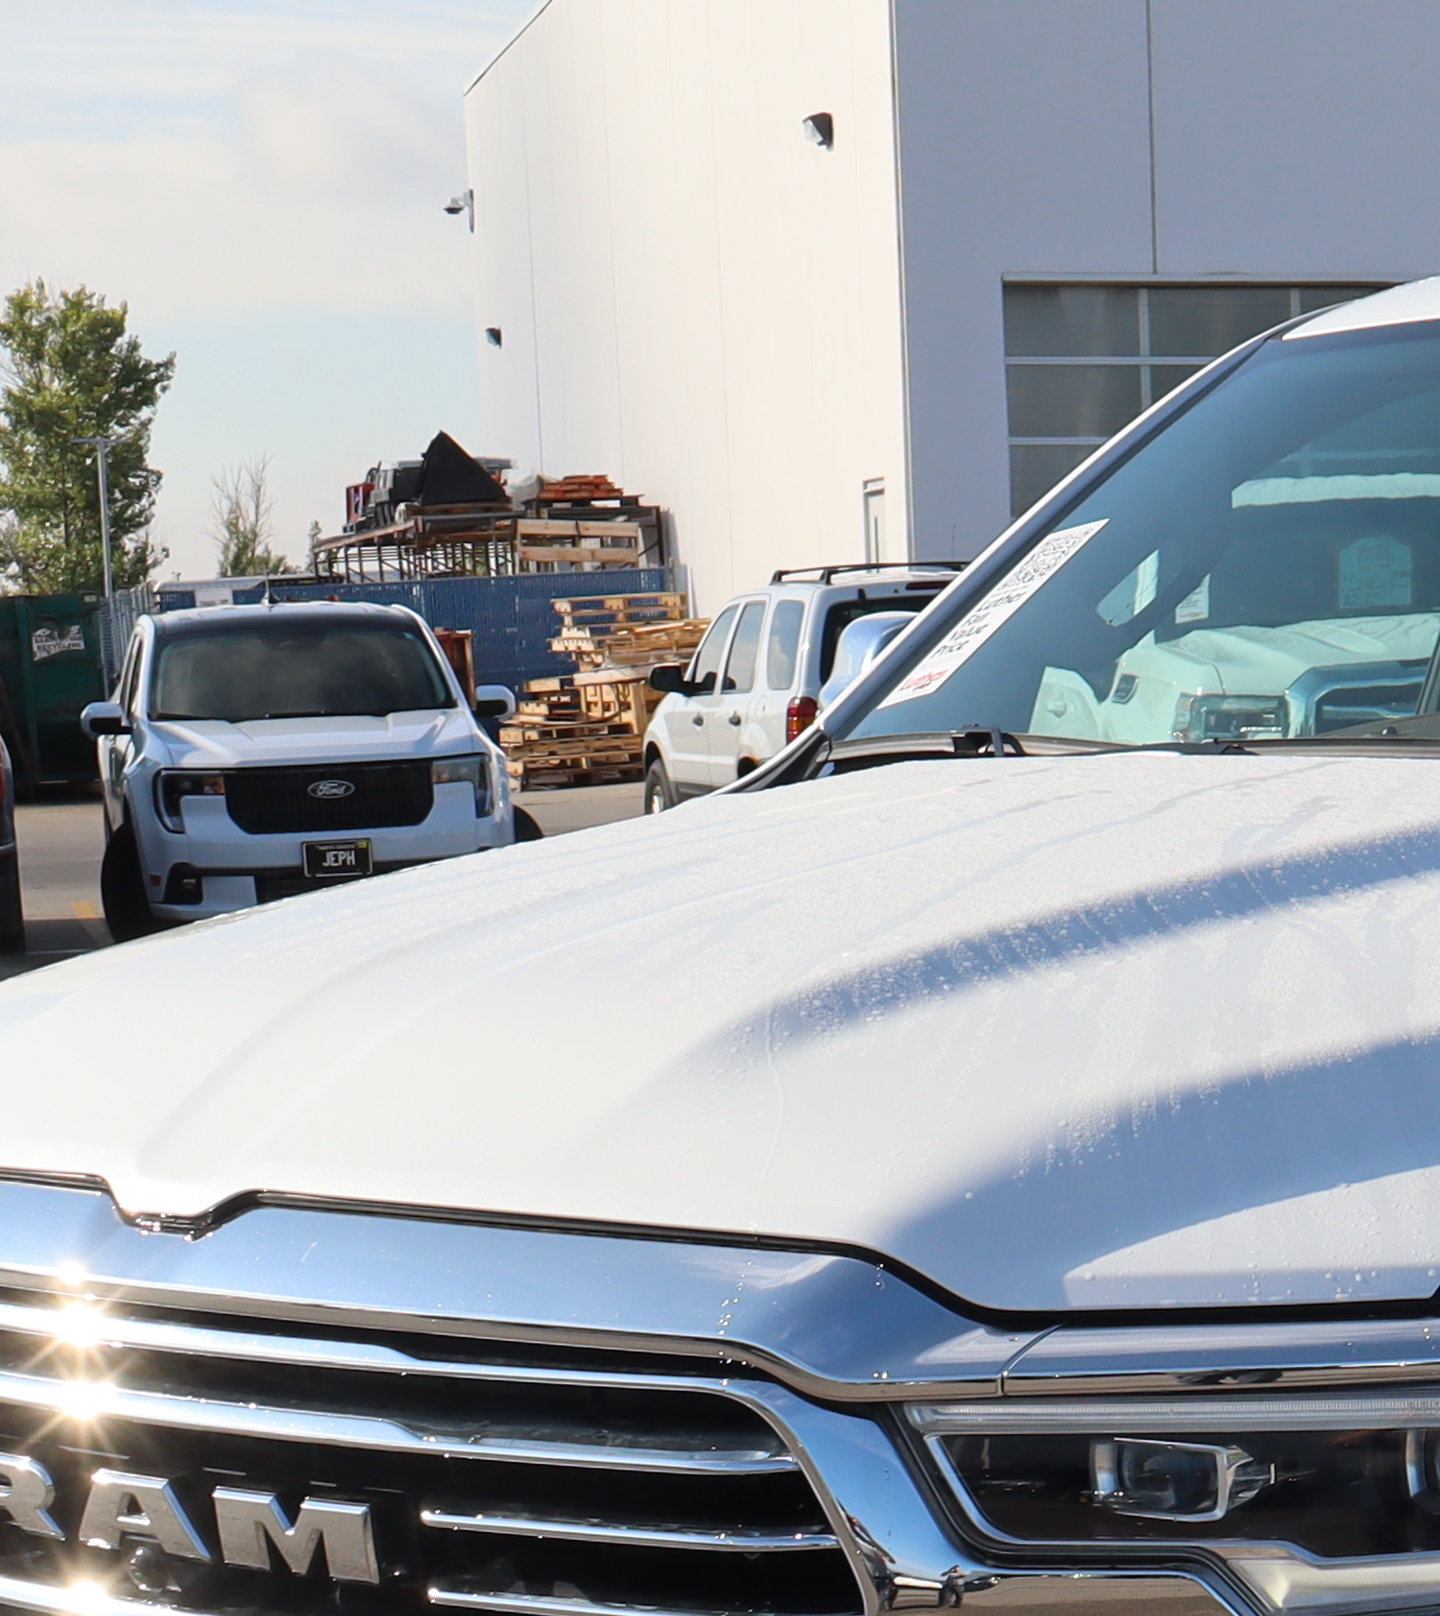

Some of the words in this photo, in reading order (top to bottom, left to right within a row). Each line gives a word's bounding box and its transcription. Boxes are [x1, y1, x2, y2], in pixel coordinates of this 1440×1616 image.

[977, 590, 1027, 612] Luther
[931, 639, 971, 657] Price
[322, 851, 356, 867] JEPH
